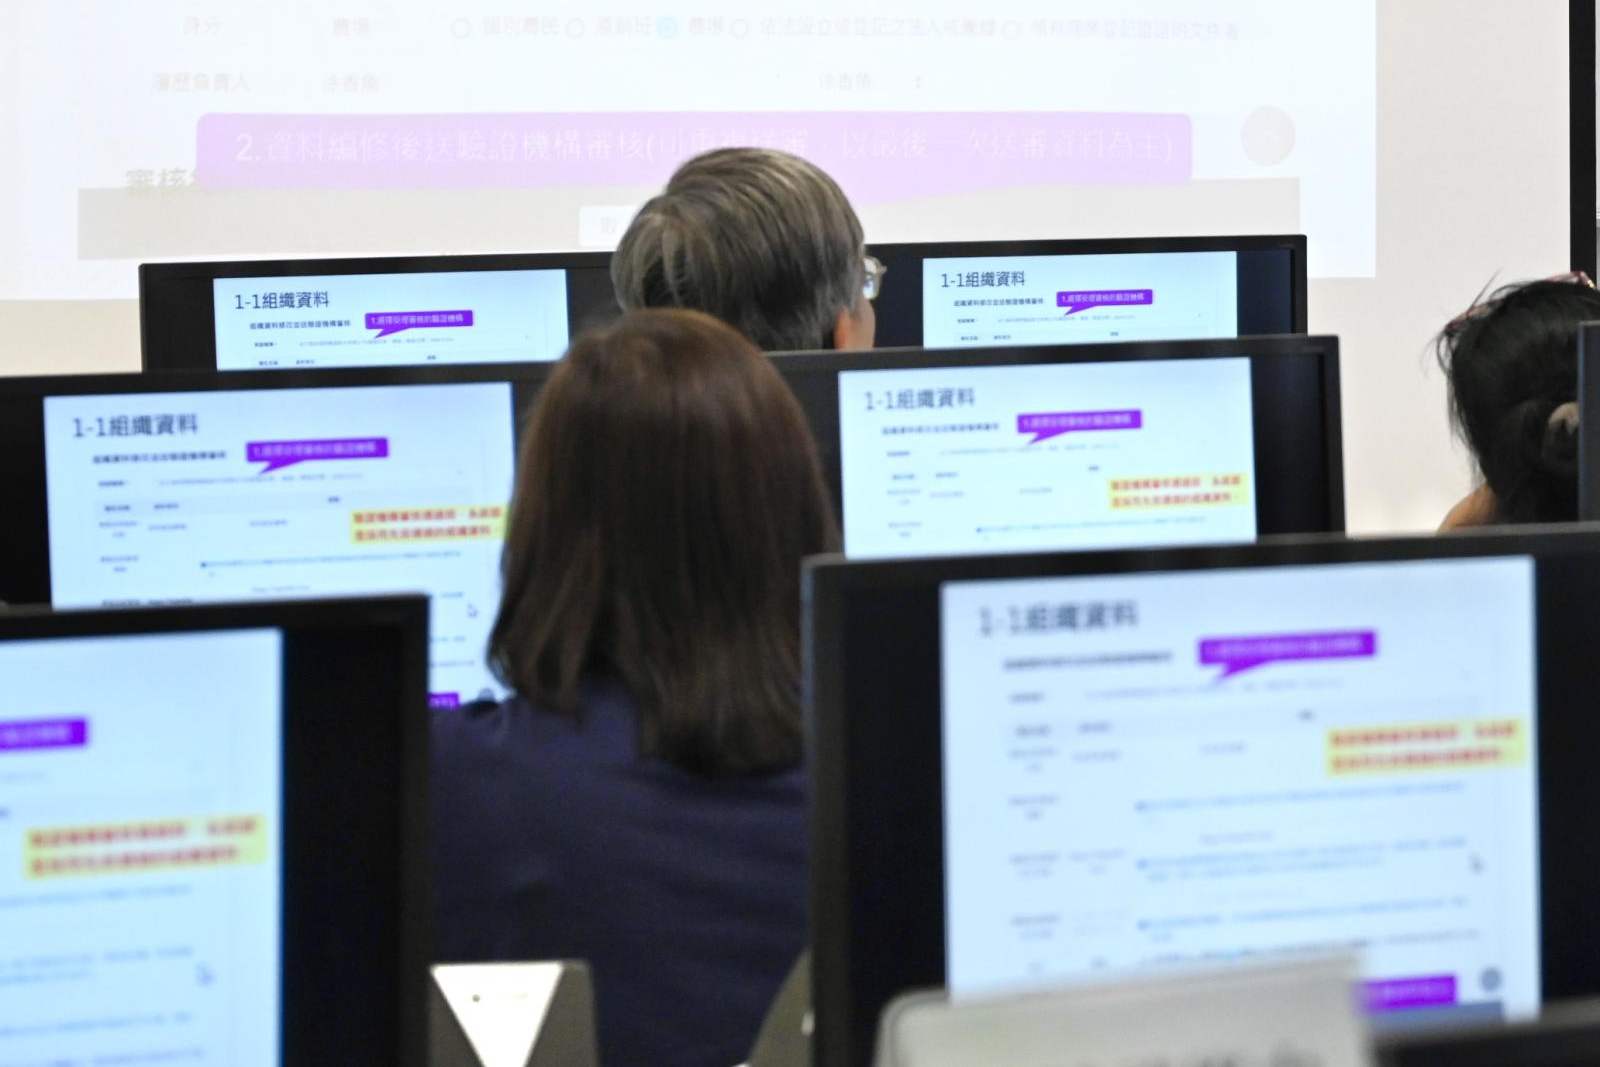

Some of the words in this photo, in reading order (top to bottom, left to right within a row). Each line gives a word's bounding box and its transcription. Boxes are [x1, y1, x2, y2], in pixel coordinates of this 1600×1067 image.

[941, 271, 1025, 288] 1-1組織資料
[235, 291, 329, 310] 1-1組織資料
